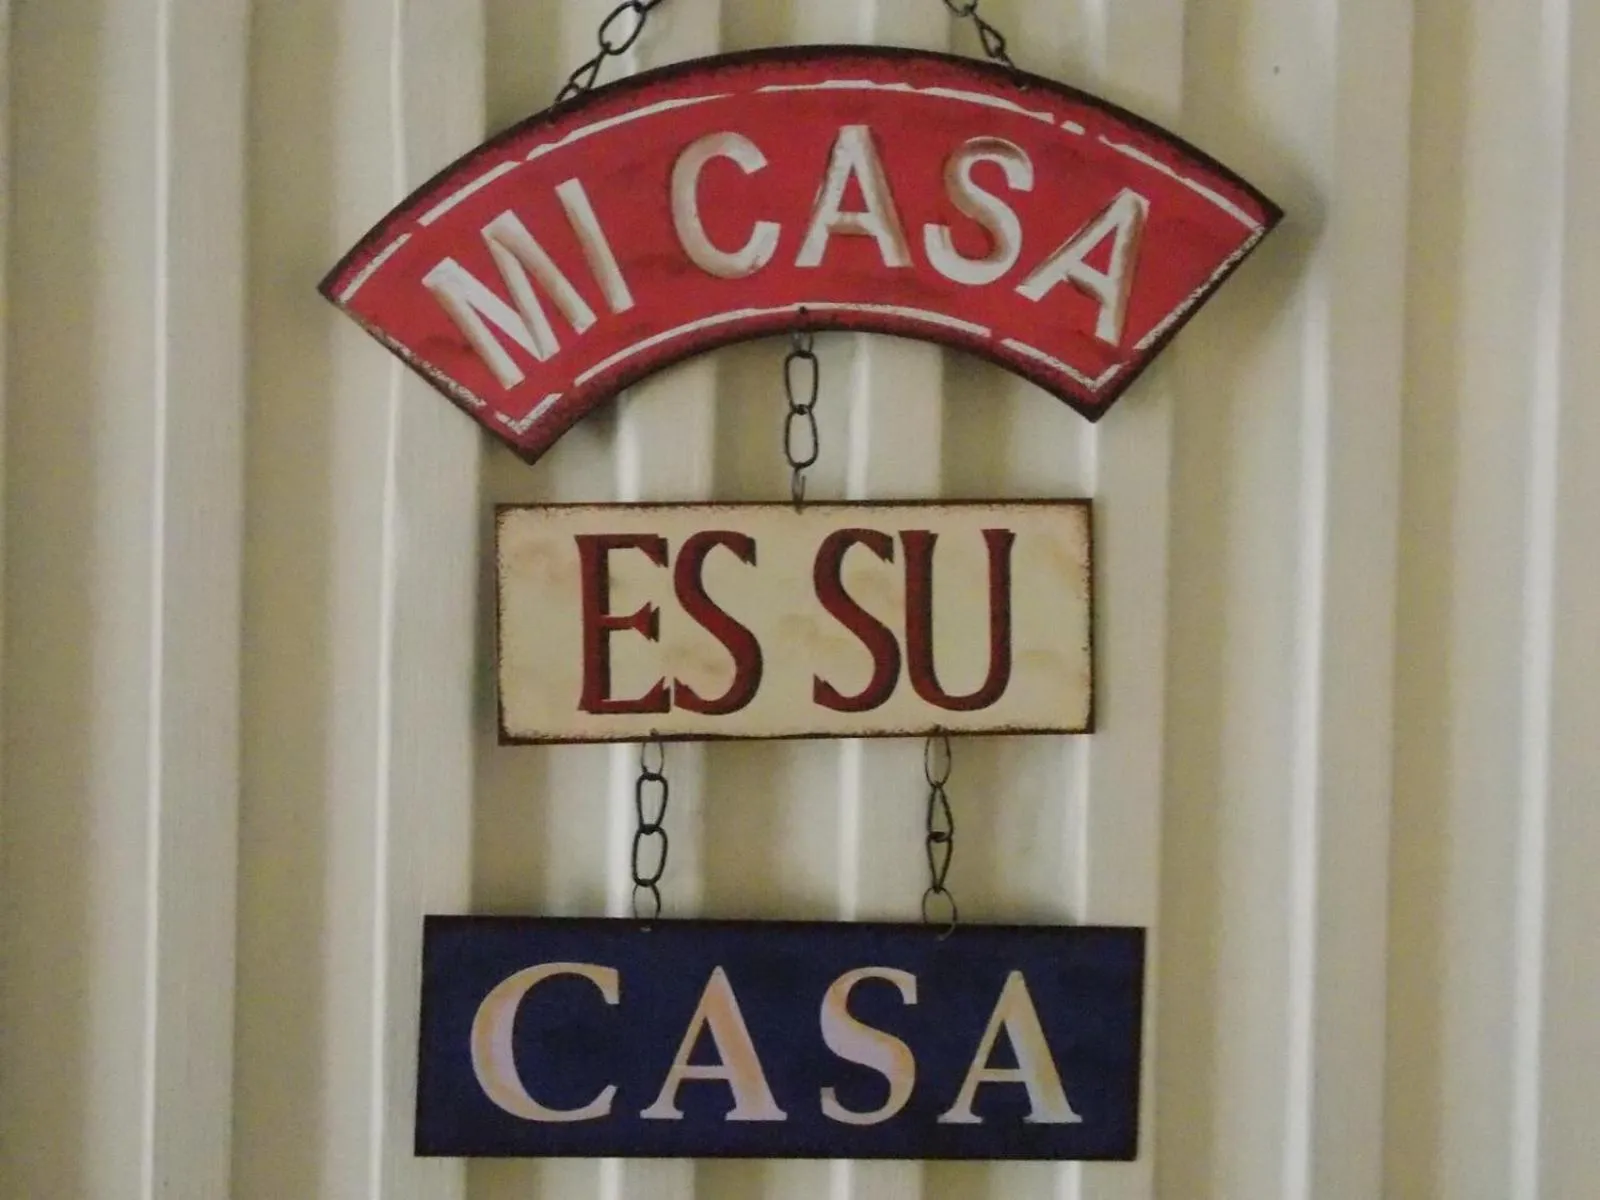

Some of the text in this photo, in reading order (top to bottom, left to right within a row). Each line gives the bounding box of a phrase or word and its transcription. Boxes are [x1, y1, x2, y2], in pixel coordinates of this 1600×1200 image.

[421, 124, 1151, 390] MI CASA
[575, 528, 1015, 715] ES SU
[470, 961, 1083, 1126] CASA
